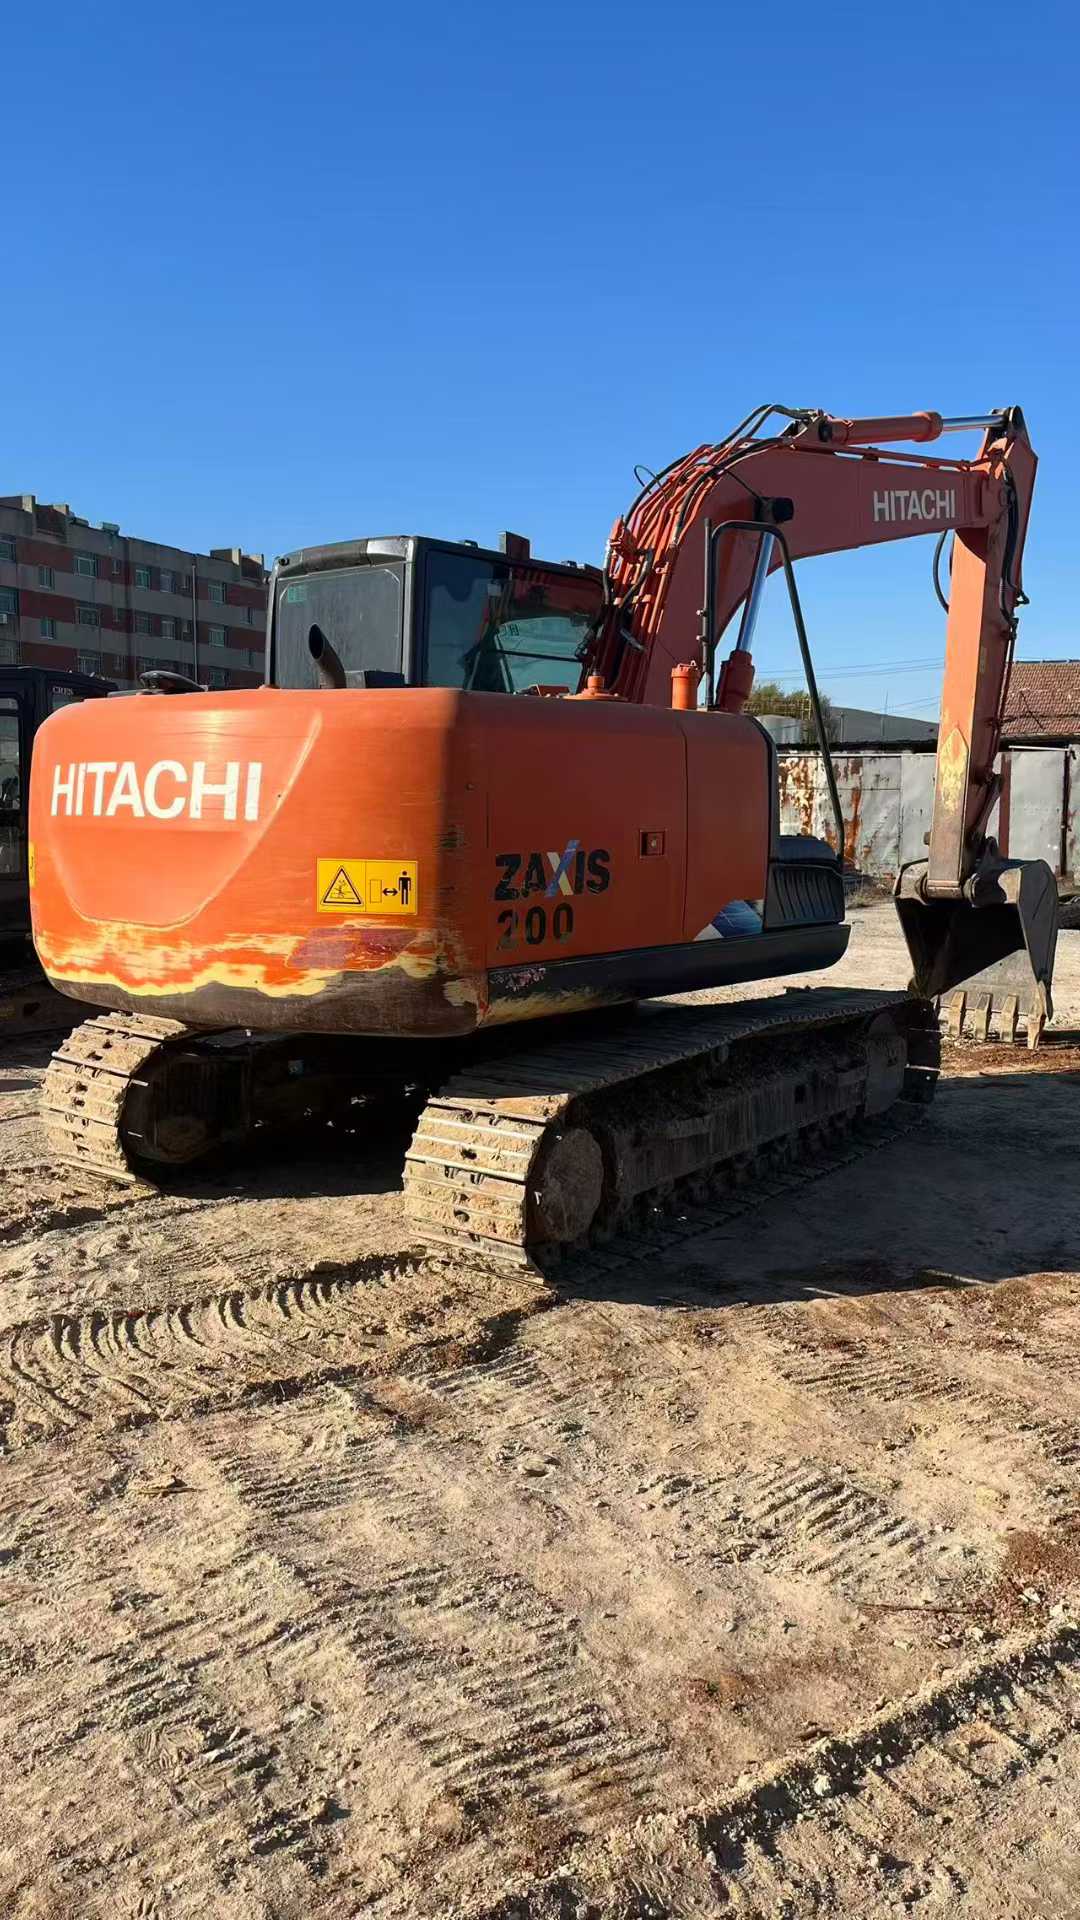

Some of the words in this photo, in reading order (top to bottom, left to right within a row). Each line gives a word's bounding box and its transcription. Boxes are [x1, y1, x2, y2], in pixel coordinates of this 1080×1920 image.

[873, 489, 956, 522] HITACHI
[51, 760, 263, 821] HITACHI
[495, 840, 611, 900] ZAXIS
[497, 902, 574, 951] 200
